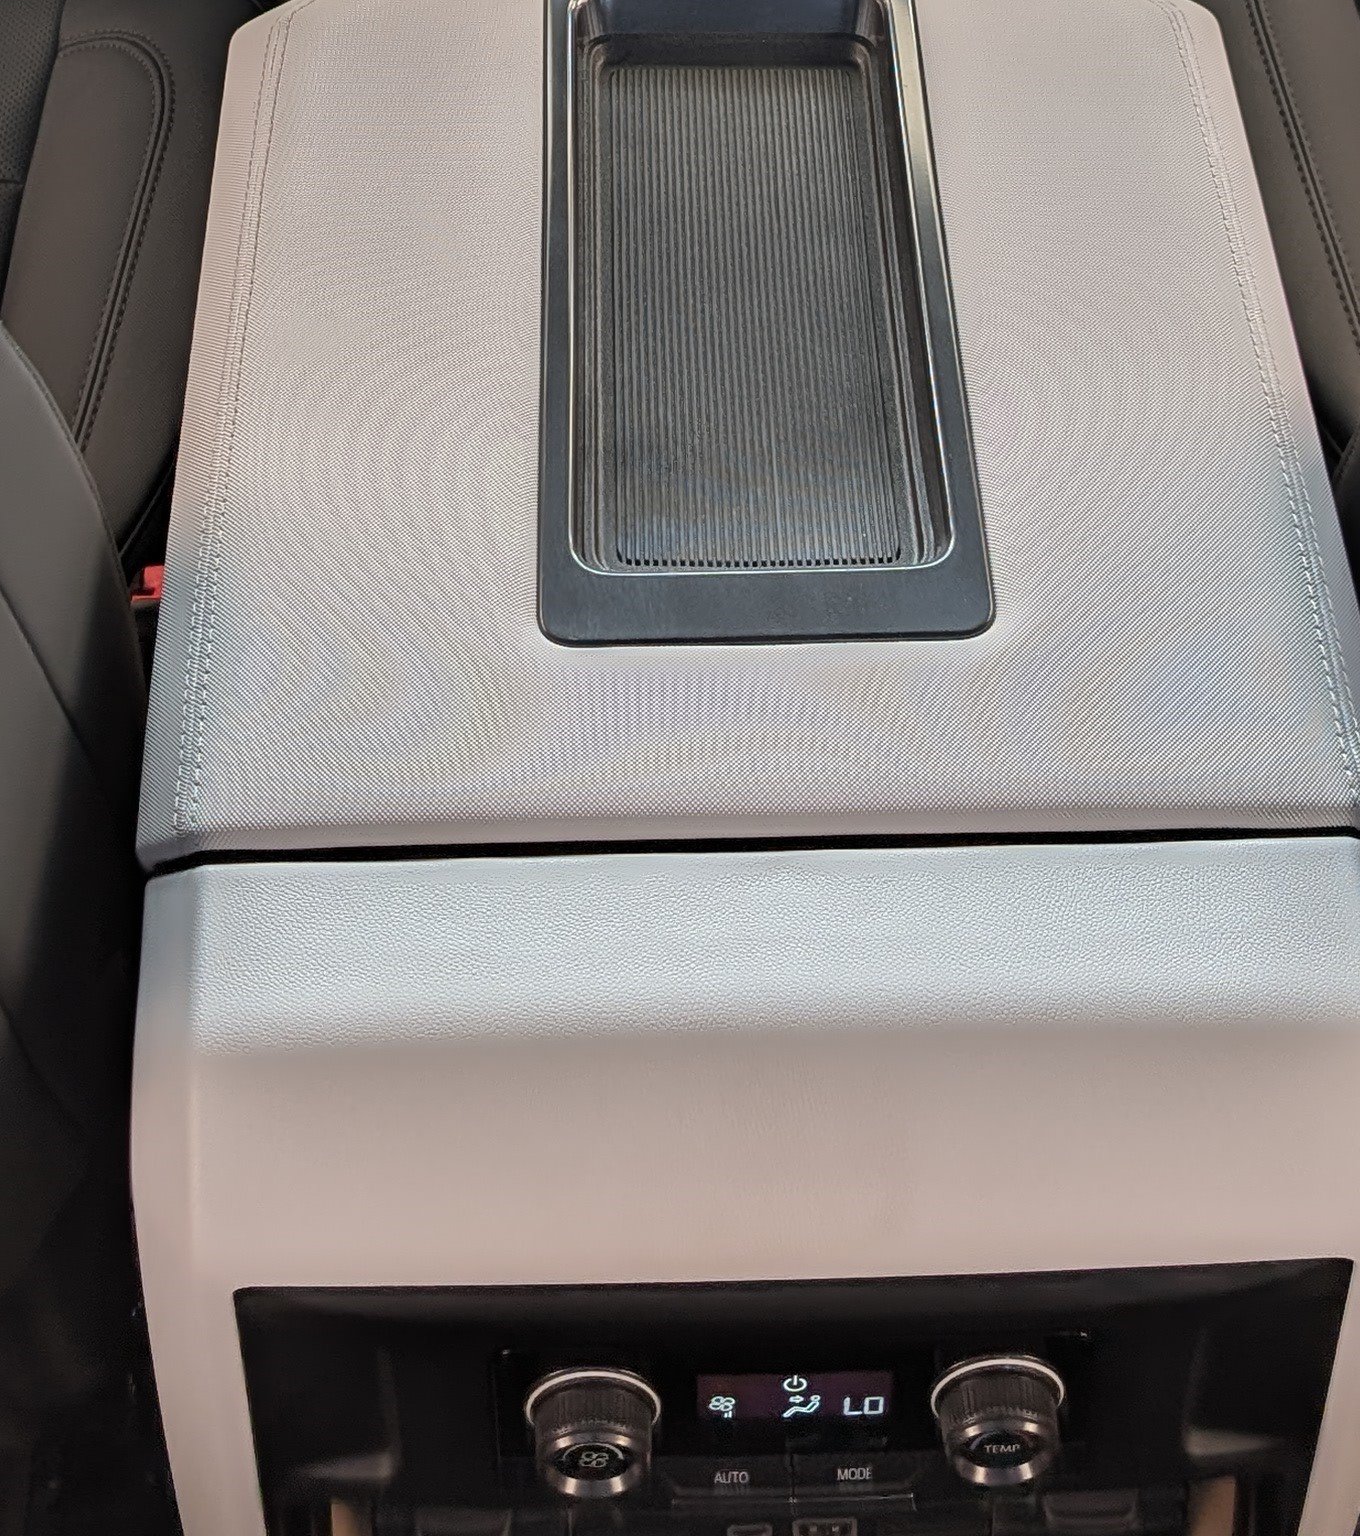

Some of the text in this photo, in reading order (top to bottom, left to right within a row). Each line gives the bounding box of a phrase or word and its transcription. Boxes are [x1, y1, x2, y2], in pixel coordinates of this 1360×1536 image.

[843, 1396, 885, 1415] LO
[984, 1443, 1021, 1454] TEMP
[714, 1471, 750, 1484] AUTO
[836, 1467, 873, 1481] MODE
